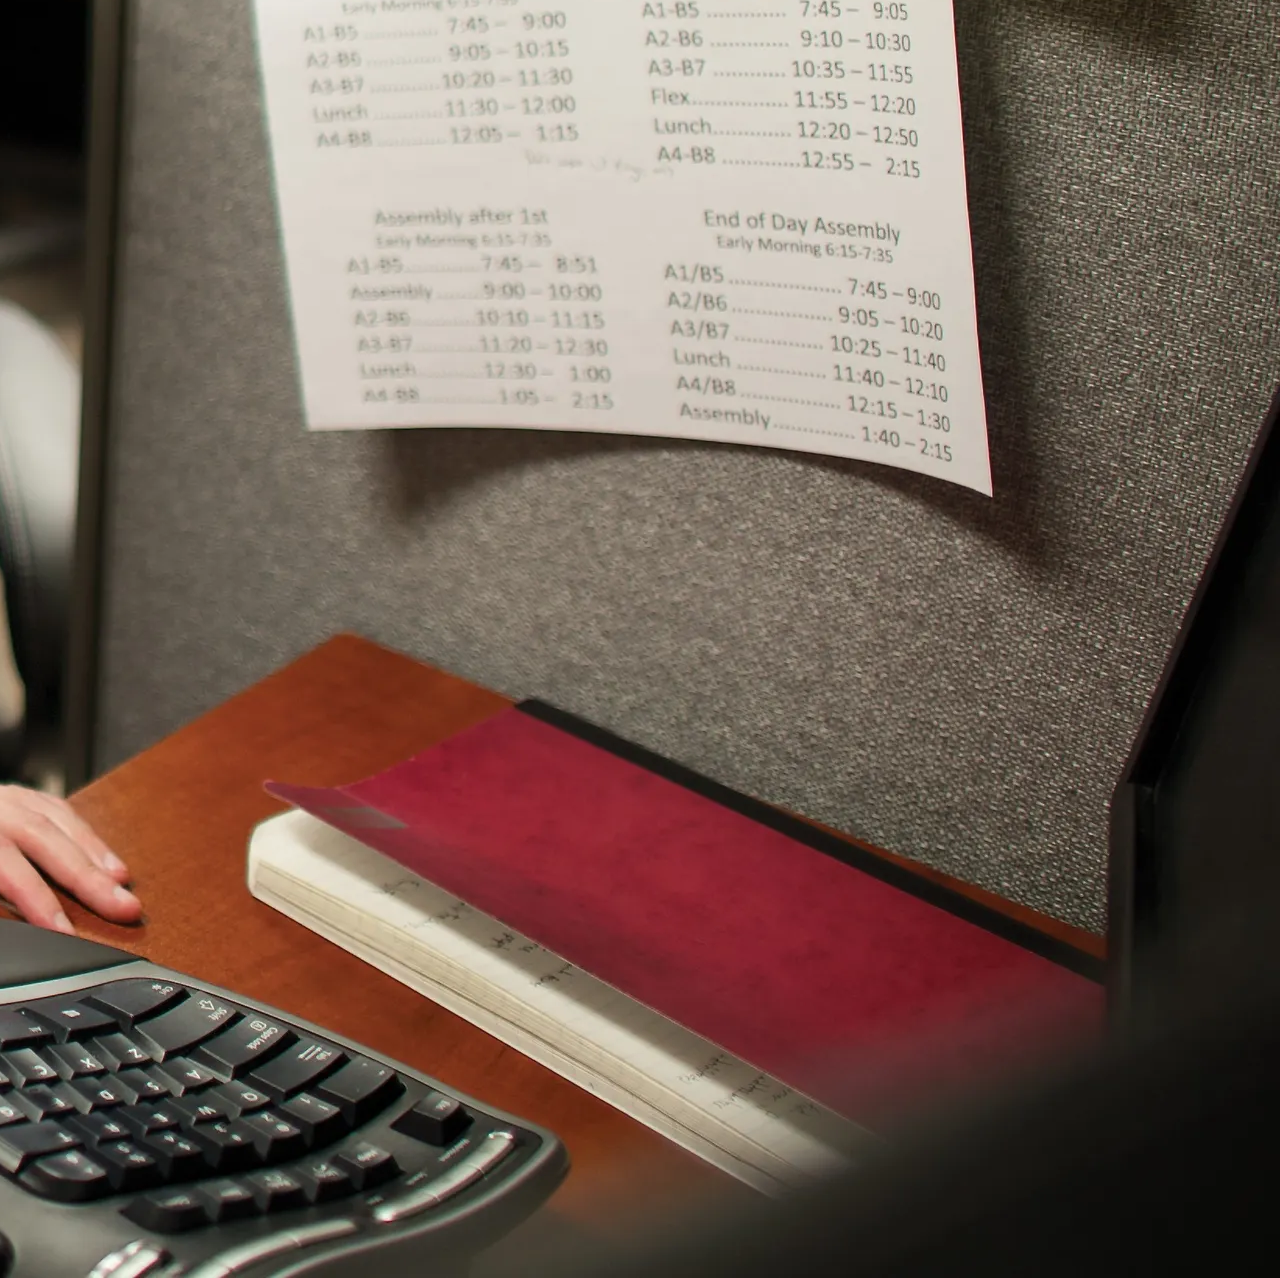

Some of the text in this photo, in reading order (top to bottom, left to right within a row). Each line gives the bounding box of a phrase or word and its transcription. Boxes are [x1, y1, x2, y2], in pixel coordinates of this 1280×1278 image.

[342, 0, 376, 15] Early
[641, 0, 909, 21] A1-B5 7:45 9:05
[447, 15, 490, 34] 7:45
[522, 11, 567, 30] 9:00
[448, 43, 491, 63] 9:05
[515, 39, 570, 59] 10:15
[644, 29, 912, 52] A2-B6 9:10 10:30
[442, 70, 496, 90] 10:20
[518, 67, 574, 87] 11:30
[647, 58, 914, 84] A3-B7 10:35 11:55
[313, 95, 577, 122] Lunch 11:30 12:00
[793, 89, 849, 110] 11:55
[870, 93, 917, 116] 12:20
[450, 126, 503, 146] 12:05
[535, 124, 580, 143] 1:15
[797, 120, 852, 141] 12:20
[872, 125, 919, 148] 12:50
[657, 145, 921, 179] A4-B8 12:55 2:15
[374, 208, 549, 227] Assembly after 1st
[703, 210, 901, 246] End of Day Assembly
[716, 234, 894, 264] Early Morning 6:15-7:35
[664, 263, 941, 311] A1/B5 7:45 9:00
[668, 291, 943, 341] A2/B6 9:05 10:20
[670, 320, 946, 372] A3/B7 10:25 11:40
[672, 347, 949, 404] Lunch 11:40 12:10
[676, 375, 951, 433] A4/B8 12:15 1:30
[679, 402, 953, 463] Assembly 1:40 2:15
[208, 1007, 228, 1021] Shift
[246, 1027, 278, 1050] Caps Lock
[80, 1057, 96, 1069] X
[127, 1048, 143, 1059] Z
[33, 1065, 47, 1076] C
[186, 1069, 201, 1080] A
[146, 1081, 160, 1092] S
[240, 1093, 258, 1102] Q
